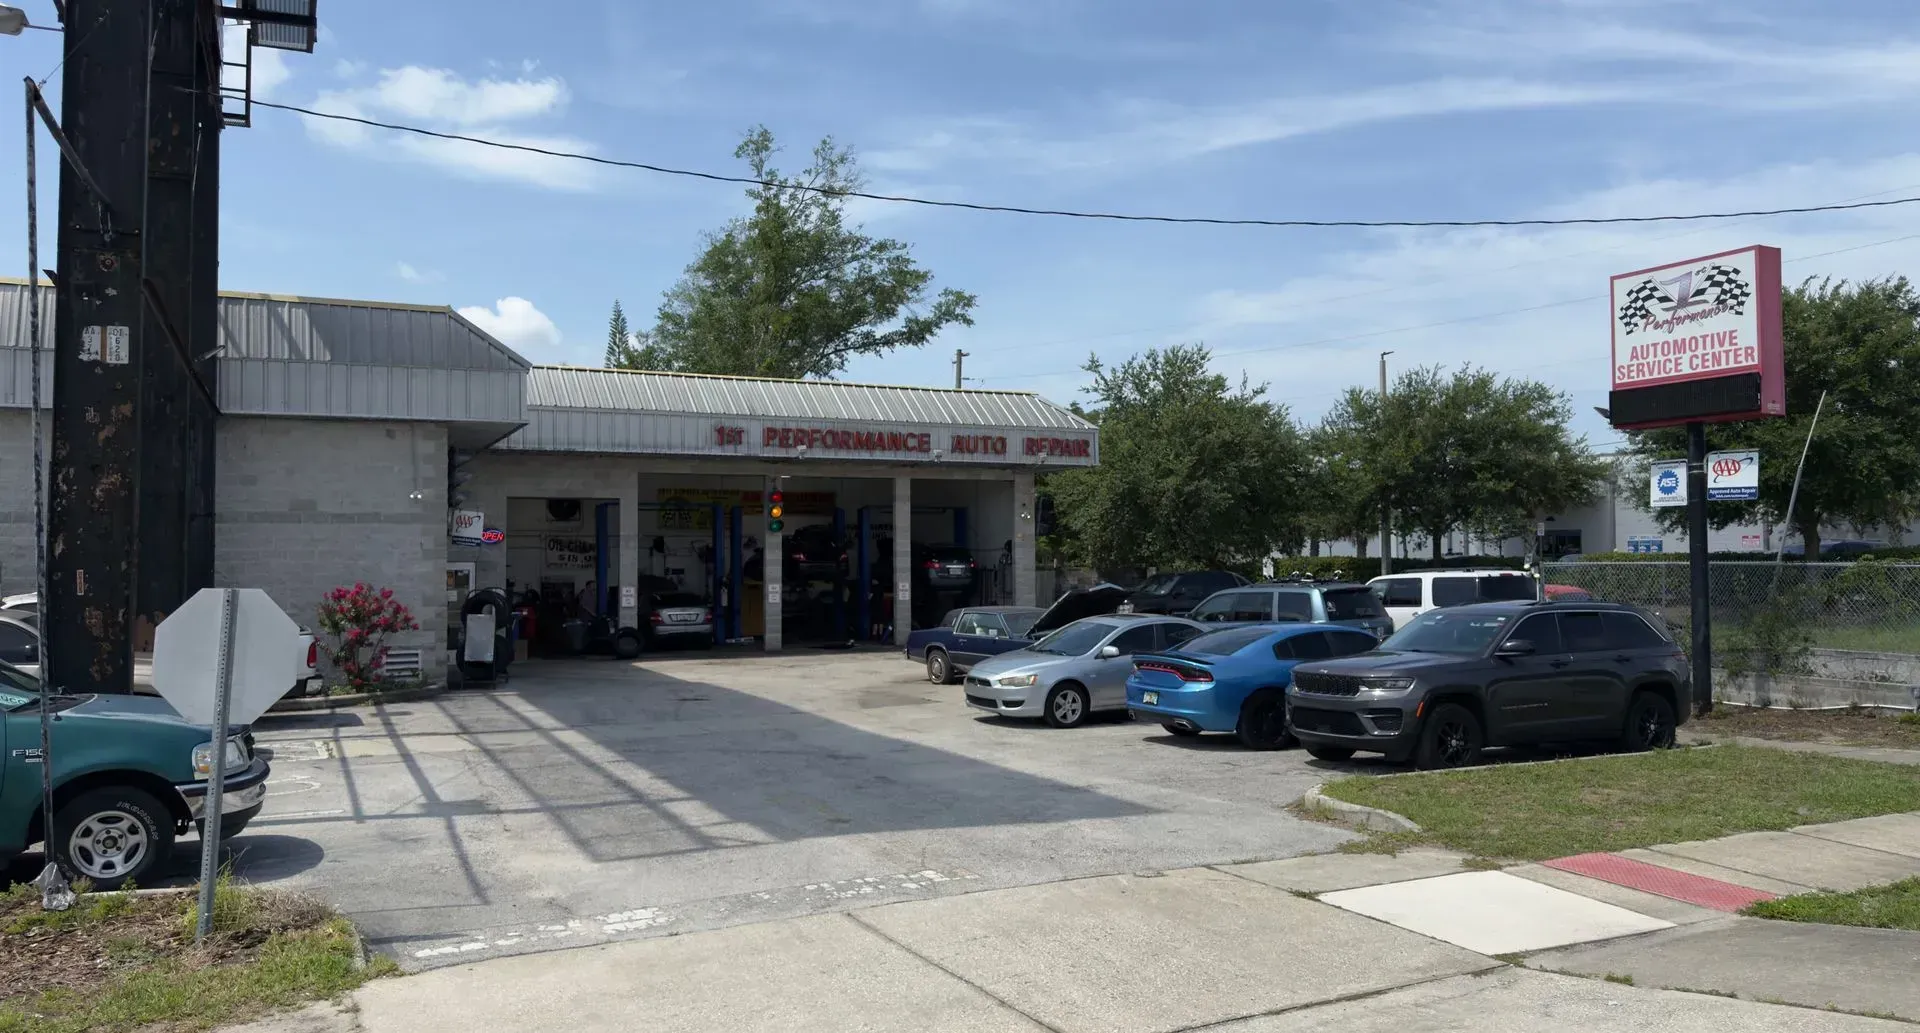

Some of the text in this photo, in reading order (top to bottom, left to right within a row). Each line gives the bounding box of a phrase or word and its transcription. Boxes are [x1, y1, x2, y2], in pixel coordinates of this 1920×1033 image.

[1643, 302, 1729, 335] Performance
[1629, 329, 1739, 363] AUTOMOTIVE
[1616, 345, 1756, 381] SERVICE CENTER
[714, 425, 1092, 458] 1ST PERFORMANCE AUTO REPAIR
[1660, 477, 1677, 488] ASE
[1714, 458, 1740, 476] AAA
[481, 531, 504, 541] OPEN
